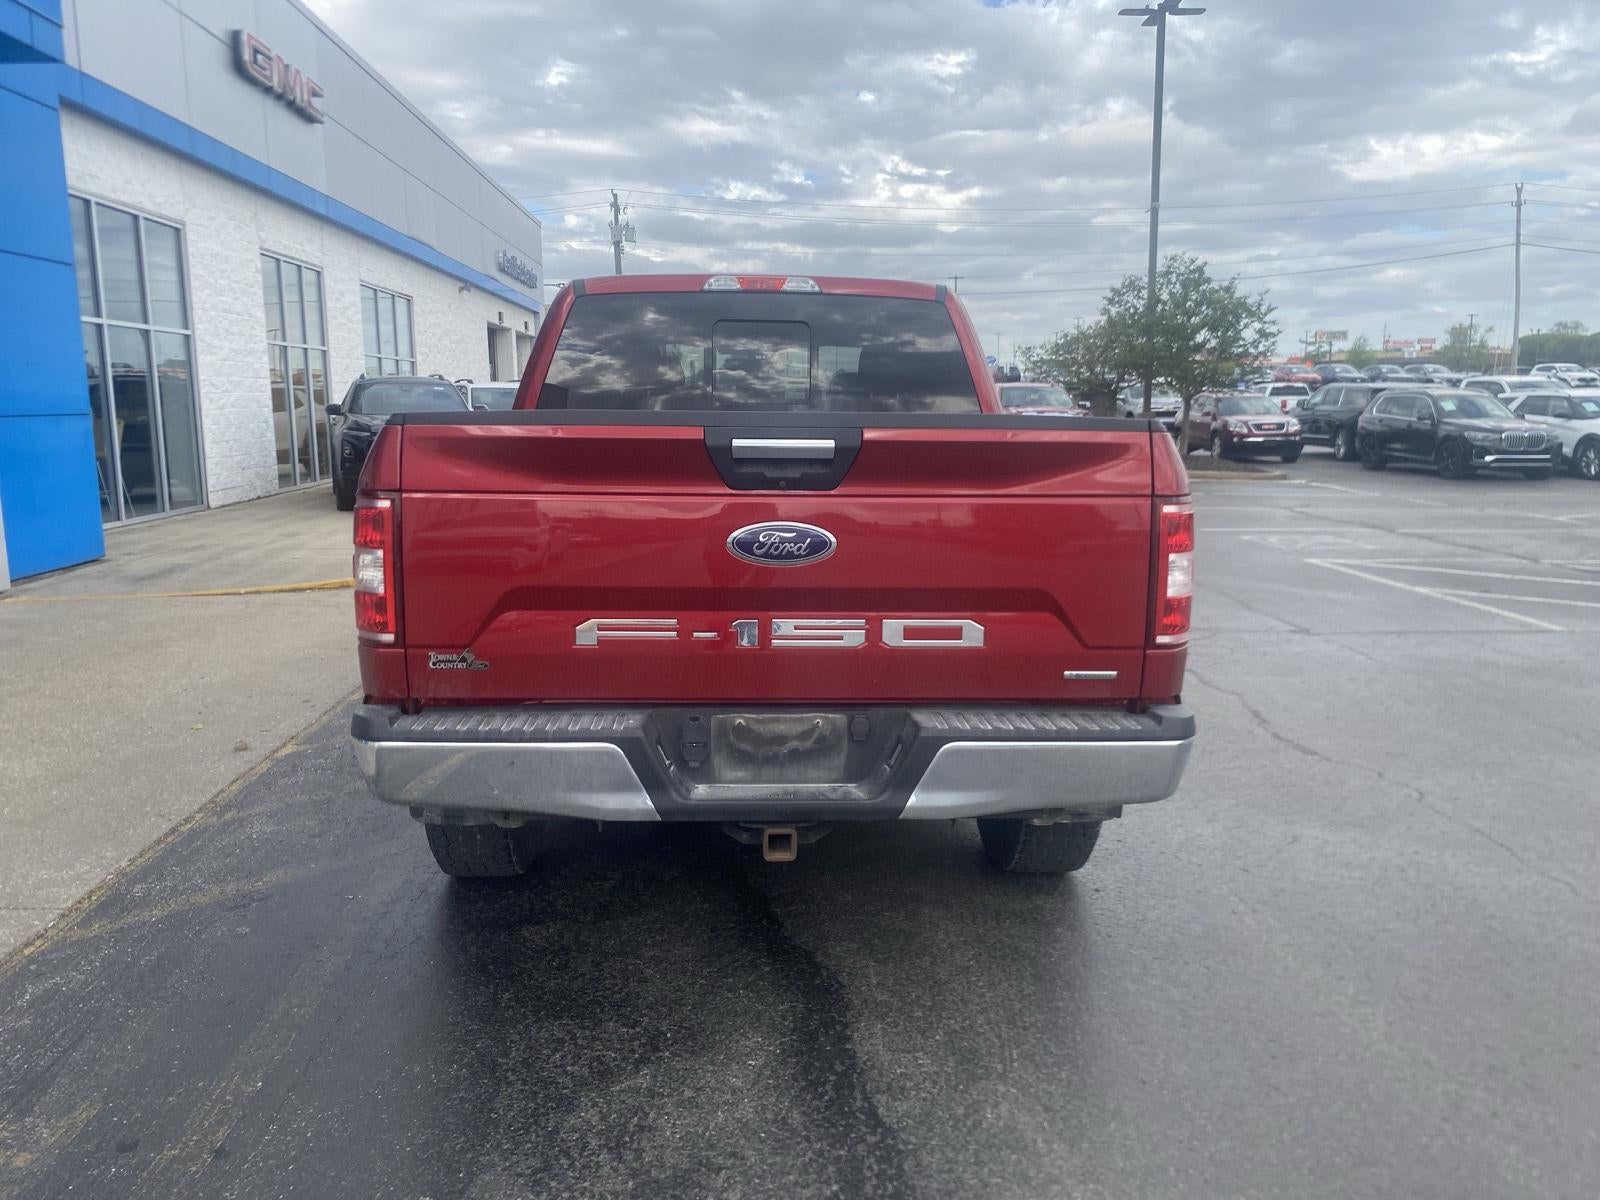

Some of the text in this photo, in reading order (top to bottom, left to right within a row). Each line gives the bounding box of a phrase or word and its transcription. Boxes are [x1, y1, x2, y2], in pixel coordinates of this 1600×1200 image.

[239, 30, 325, 124] GMC
[753, 531, 810, 557] Ford
[572, 617, 985, 649] F-150
[429, 660, 467, 669] COUNTRY
